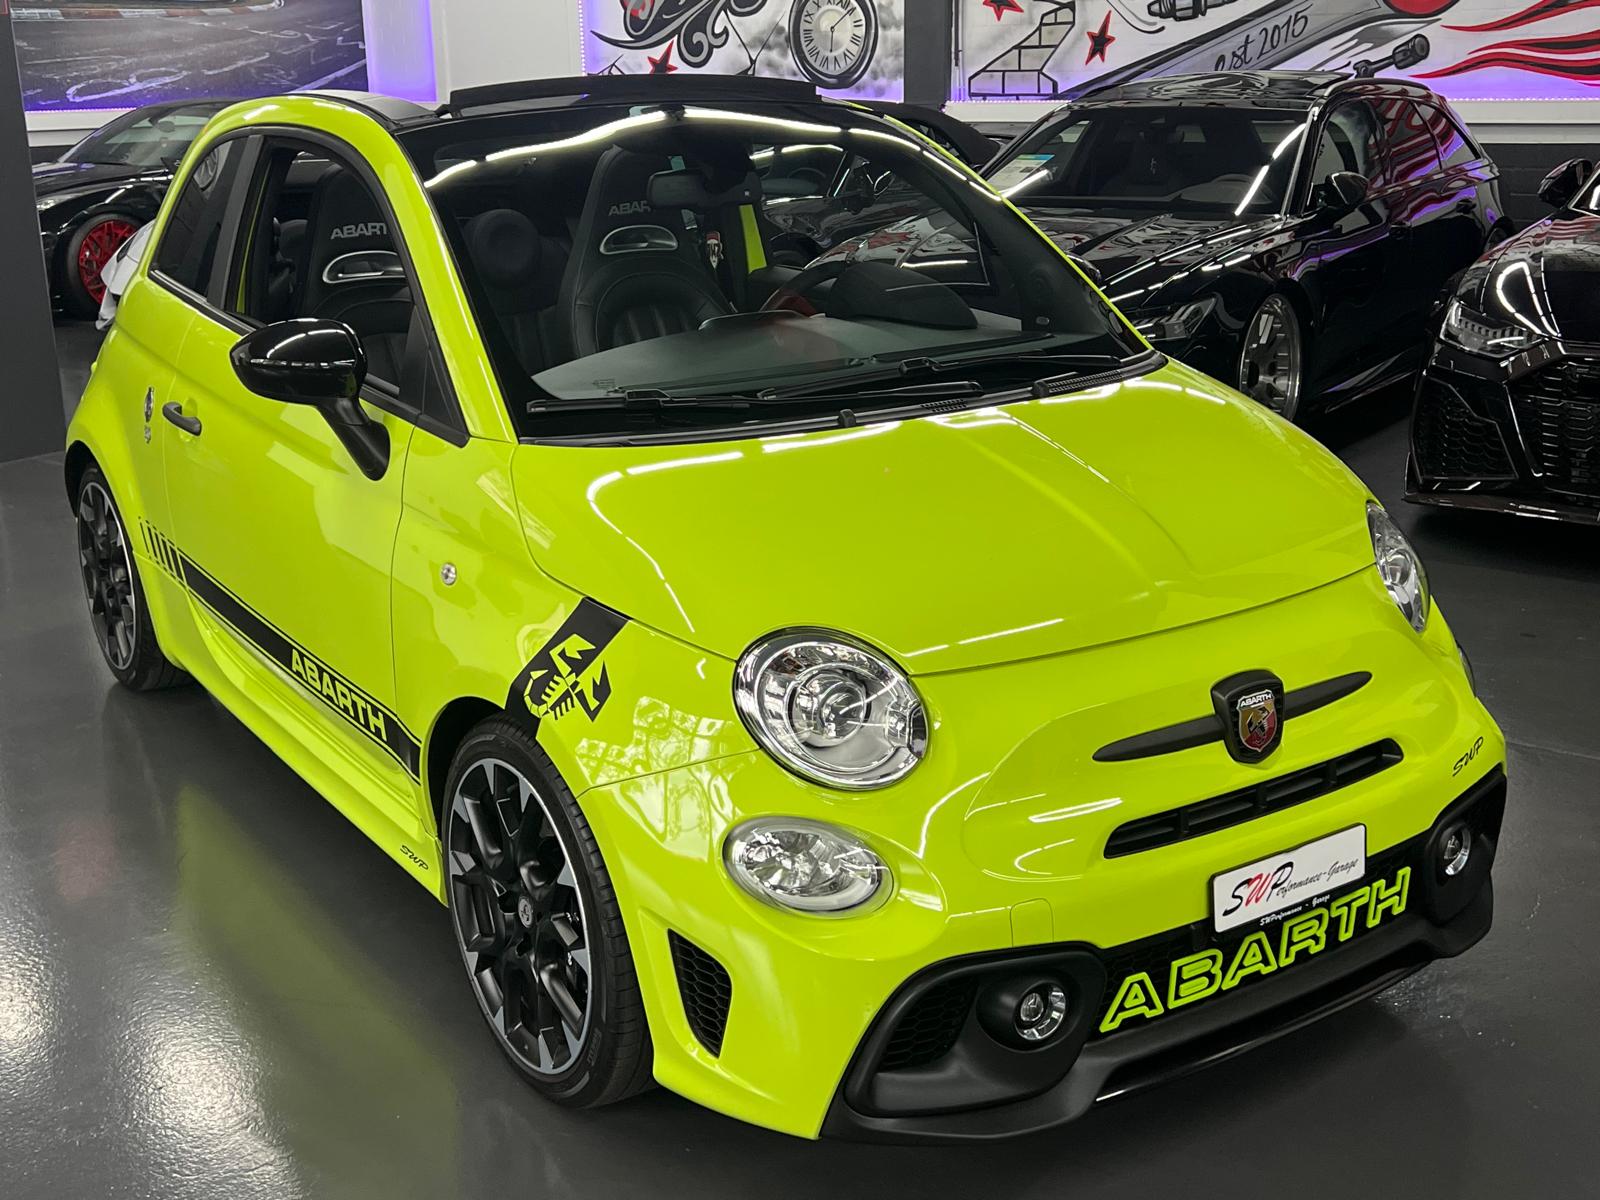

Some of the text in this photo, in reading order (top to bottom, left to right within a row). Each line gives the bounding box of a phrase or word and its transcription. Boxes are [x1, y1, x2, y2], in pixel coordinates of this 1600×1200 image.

[1257, 3, 1313, 60] 2015
[330, 222, 387, 240] ABART
[291, 648, 388, 742] ABARTH
[1240, 693, 1272, 707] ABARTH
[1452, 736, 1484, 777] SWP
[1099, 866, 1411, 1033] ABARTH
